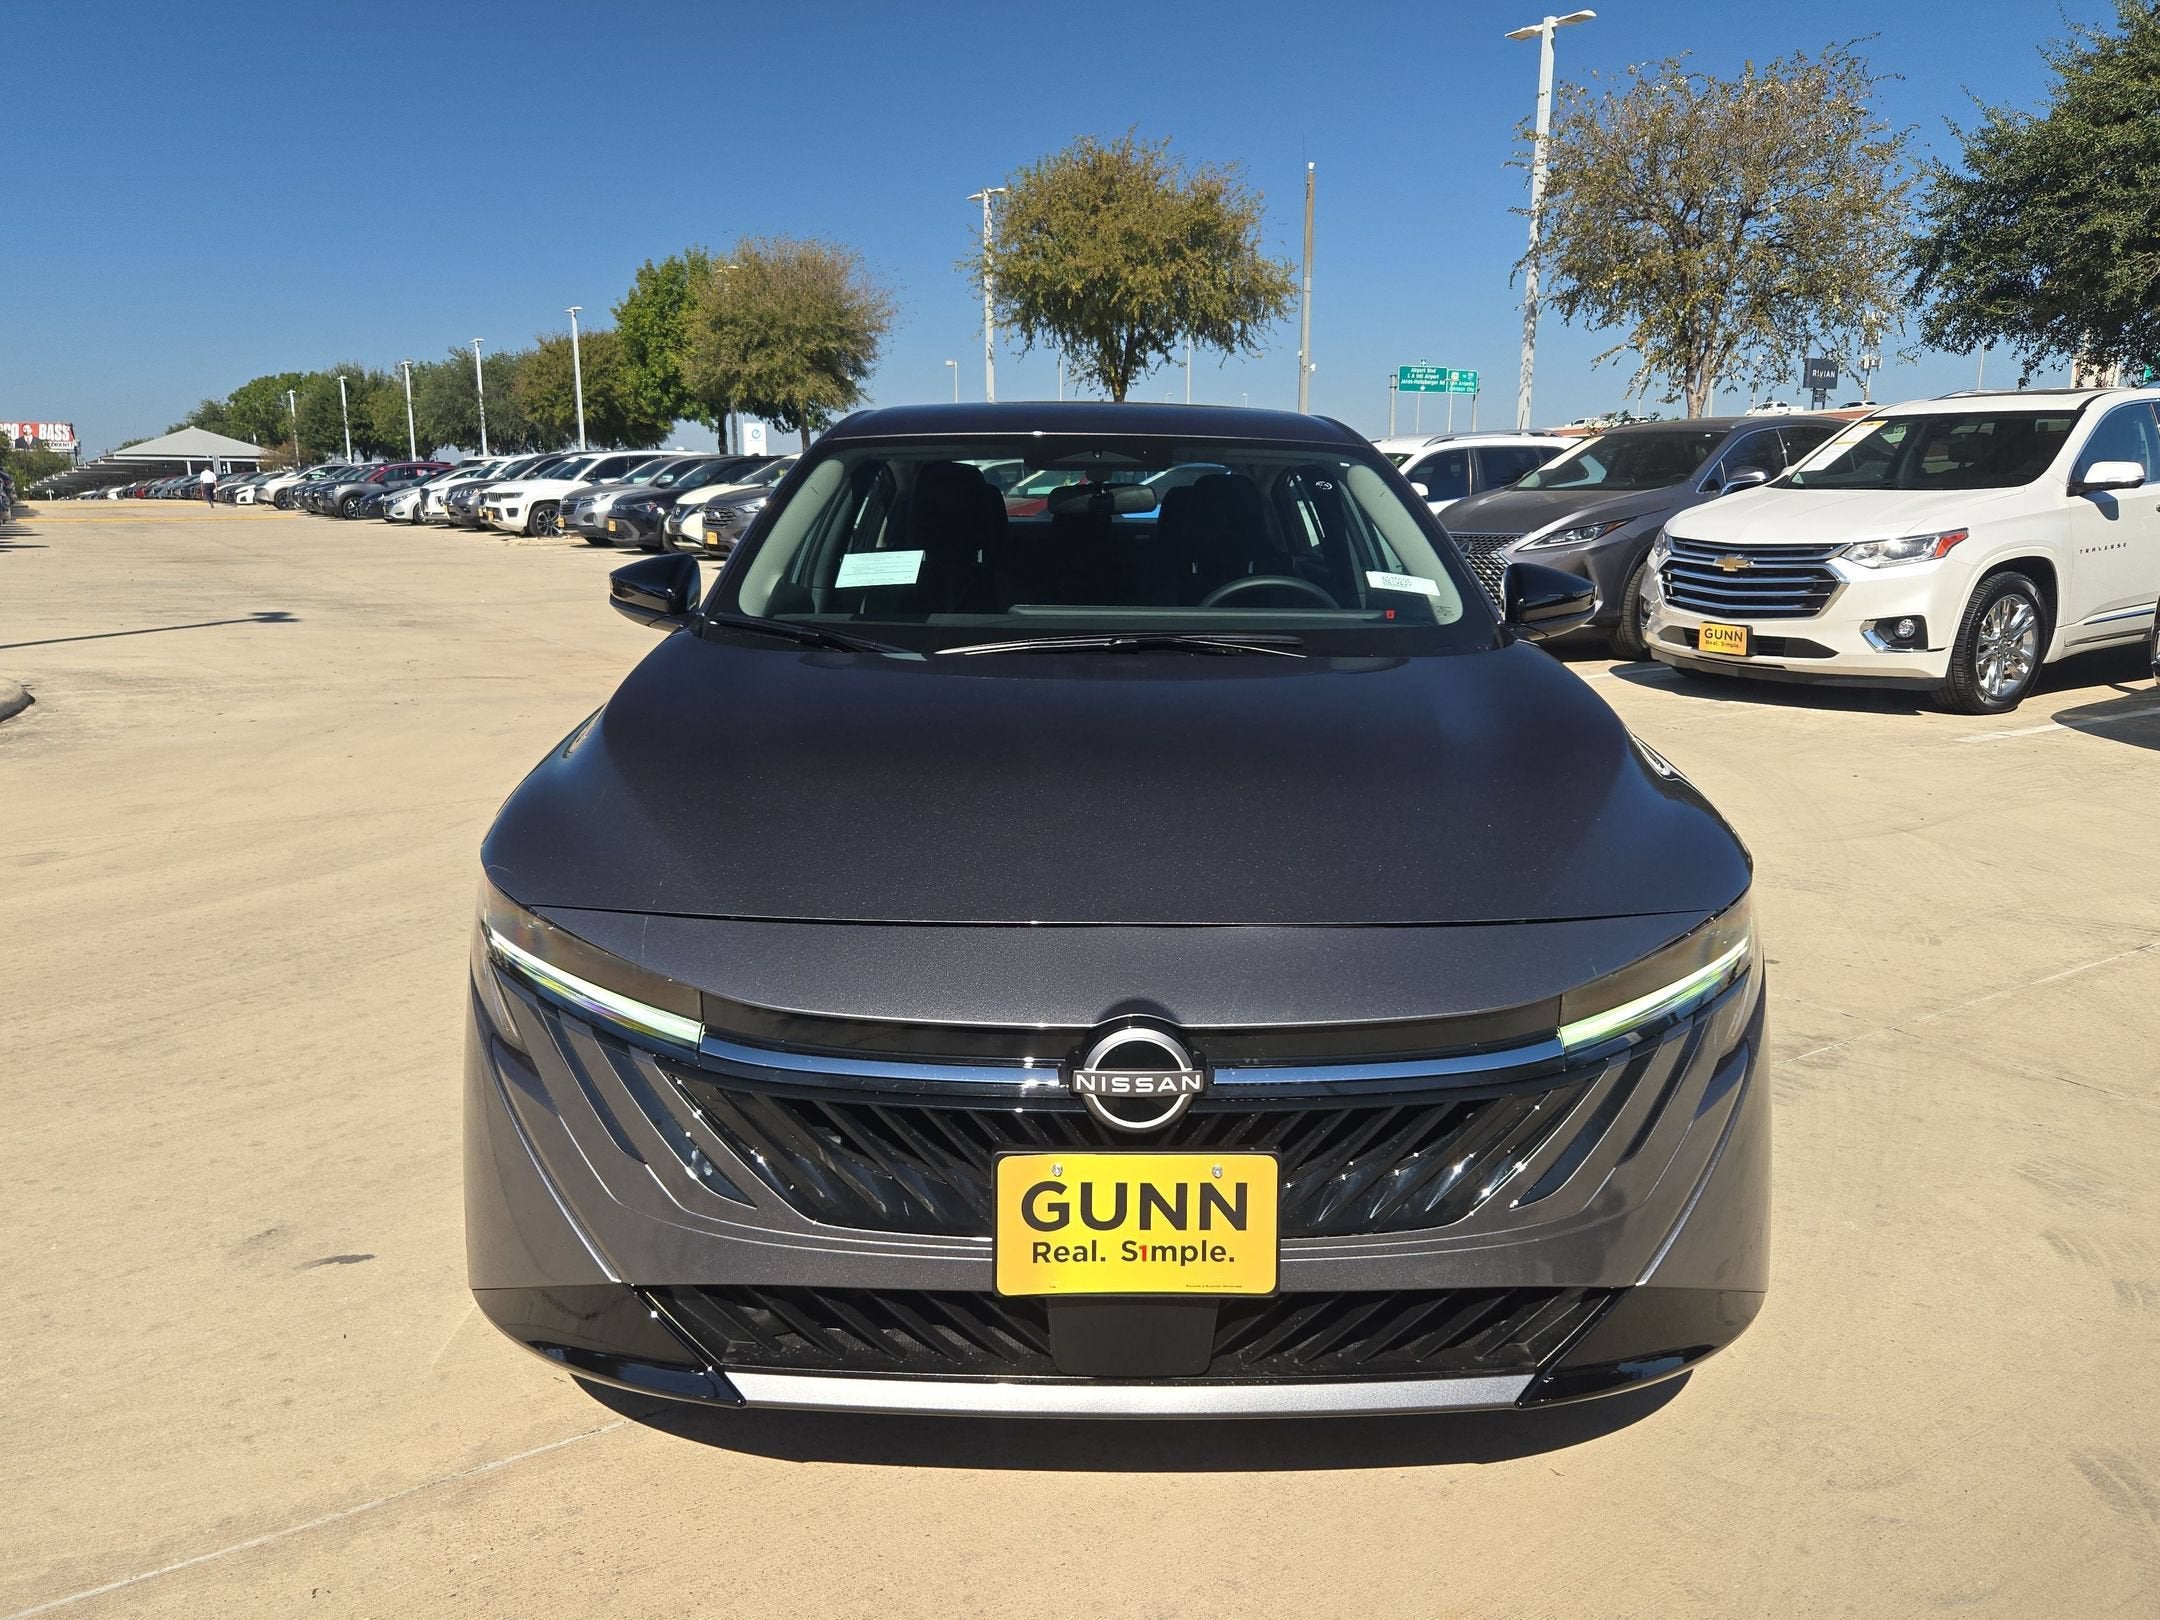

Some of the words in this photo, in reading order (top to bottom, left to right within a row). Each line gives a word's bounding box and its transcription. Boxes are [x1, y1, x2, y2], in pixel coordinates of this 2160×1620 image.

[1812, 369, 1836, 378] RIVIAN
[39, 423, 70, 441] BASS
[1704, 627, 1743, 642] GUNN
[1076, 1074, 1201, 1093] NISSAN
[1021, 1180, 1248, 1232] GUNN
[1032, 1239, 1106, 1264] Real.
